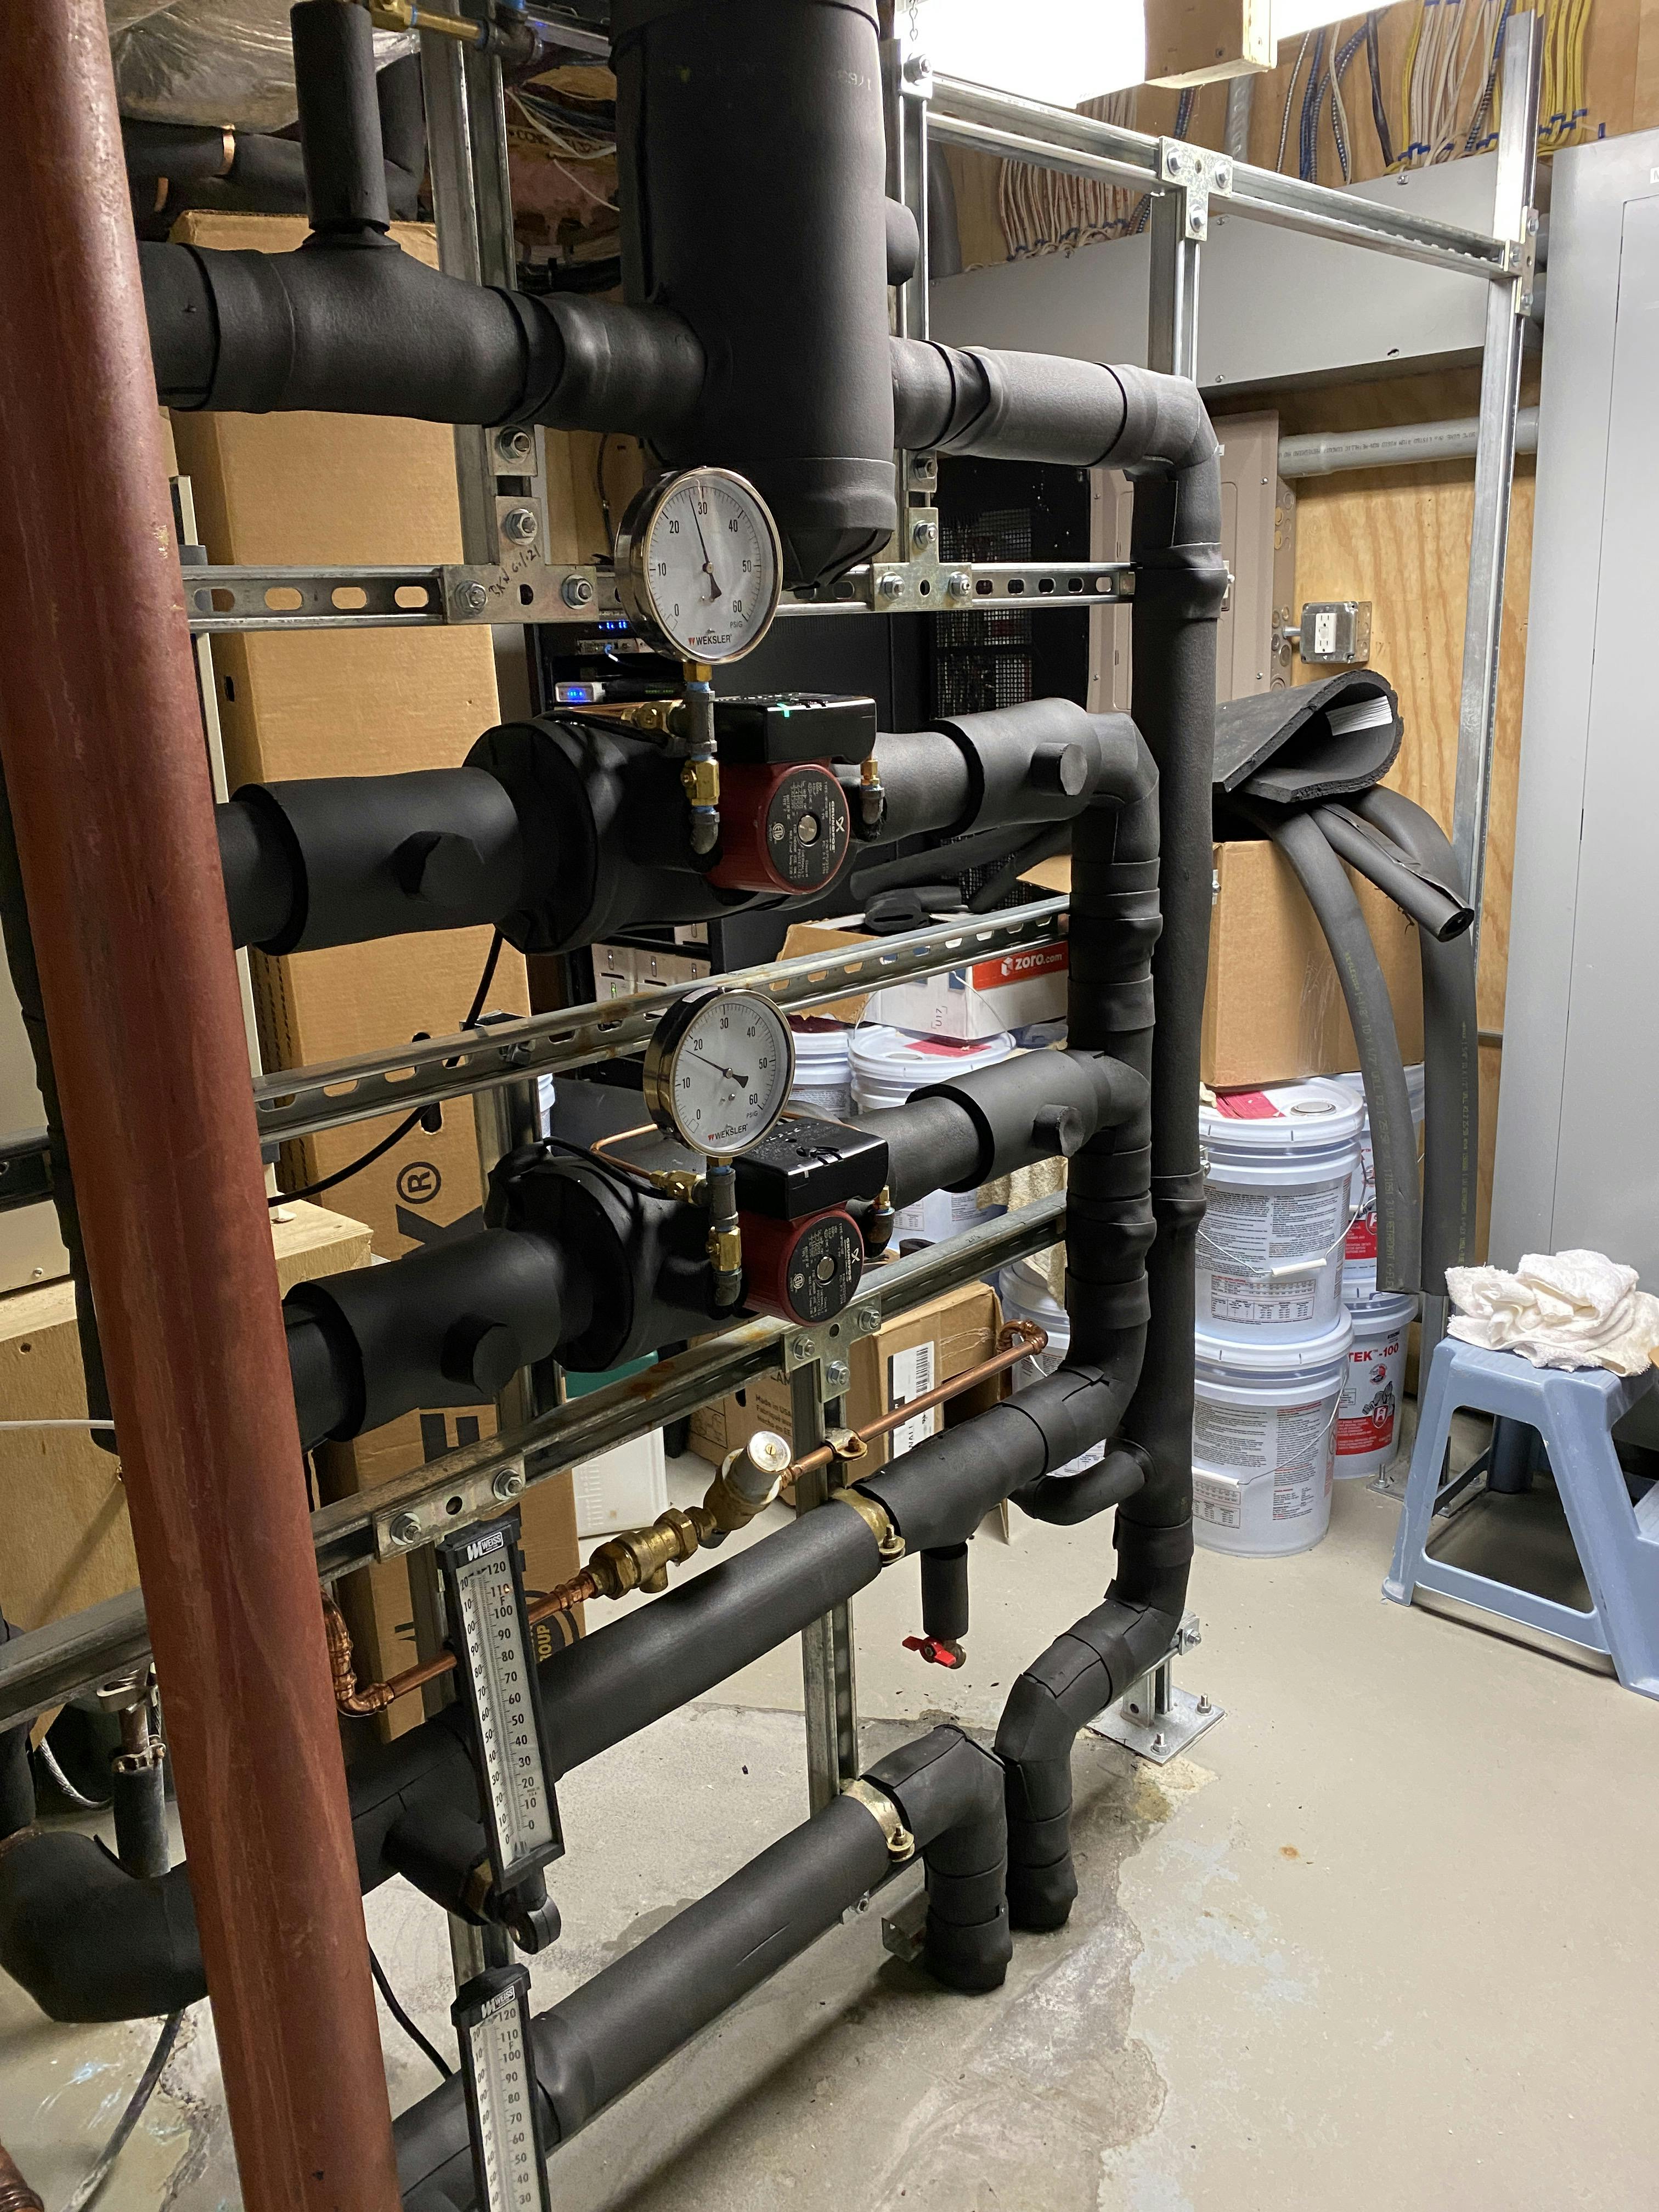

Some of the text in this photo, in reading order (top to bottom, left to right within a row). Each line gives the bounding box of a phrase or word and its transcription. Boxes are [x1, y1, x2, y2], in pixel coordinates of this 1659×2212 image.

[698, 501, 708, 515] 30
[669, 521, 679, 533] 20
[729, 520, 738, 532] 40
[658, 563, 666, 576] 10
[743, 560, 752, 573] 50
[674, 604, 679, 617] 0
[733, 600, 742, 613] 60
[696, 635, 731, 646] WEKSLER
[720, 1018, 729, 1029] 30
[747, 1026, 755, 1037] 40
[693, 1039, 703, 1051] 20
[759, 1058, 767, 1069] 50
[682, 1077, 690, 1088] 10
[749, 1093, 758, 1105] 60
[697, 1109, 701, 1120] 0
[746, 1110, 758, 1119] PSIG
[715, 1125, 747, 1140] WEKSLER
[481, 1534, 501, 1550] WEISS
[488, 1561, 506, 1575] 120
[500, 1597, 505, 1606] F
[494, 1605, 512, 1618] 100
[498, 1628, 511, 1640] 90
[471, 1643, 478, 1656] 90
[501, 1649, 514, 1662] 80
[474, 1665, 482, 1678] 80
[505, 1671, 517, 1684] 70
[478, 1685, 486, 1700] 70
[508, 1692, 521, 1705] 60
[482, 1707, 489, 1722] 60
[512, 1713, 524, 1726] 50
[485, 1729, 493, 1743] 50
[515, 1735, 528, 1746] 40
[489, 1750, 496, 1764] 40
[518, 1756, 531, 1768] 30
[492, 1771, 500, 1785] 30
[522, 1776, 534, 1788] 20
[495, 1792, 503, 1807] 20
[524, 1797, 537, 1810] 10
[499, 1814, 506, 1827] 10
[528, 1819, 534, 1830] 0
[505, 1833, 509, 1844] 0
[495, 1989, 514, 2005] WEISS
[499, 2008, 516, 2022] 120
[500, 2029, 518, 2042] 110
[509, 2041, 514, 2051] F
[504, 2050, 521, 2063] 100
[506, 2072, 518, 2084] 90
[508, 2092, 520, 2104] 80
[483, 2110, 489, 2125] 80
[510, 2112, 522, 2125] 70
[485, 2130, 492, 2146] 70
[513, 2132, 524, 2145] 60
[487, 2151, 494, 2165] 60
[515, 2153, 527, 2165] 50
[518, 2172, 529, 2184] 40
[520, 2192, 531, 2204] 30
